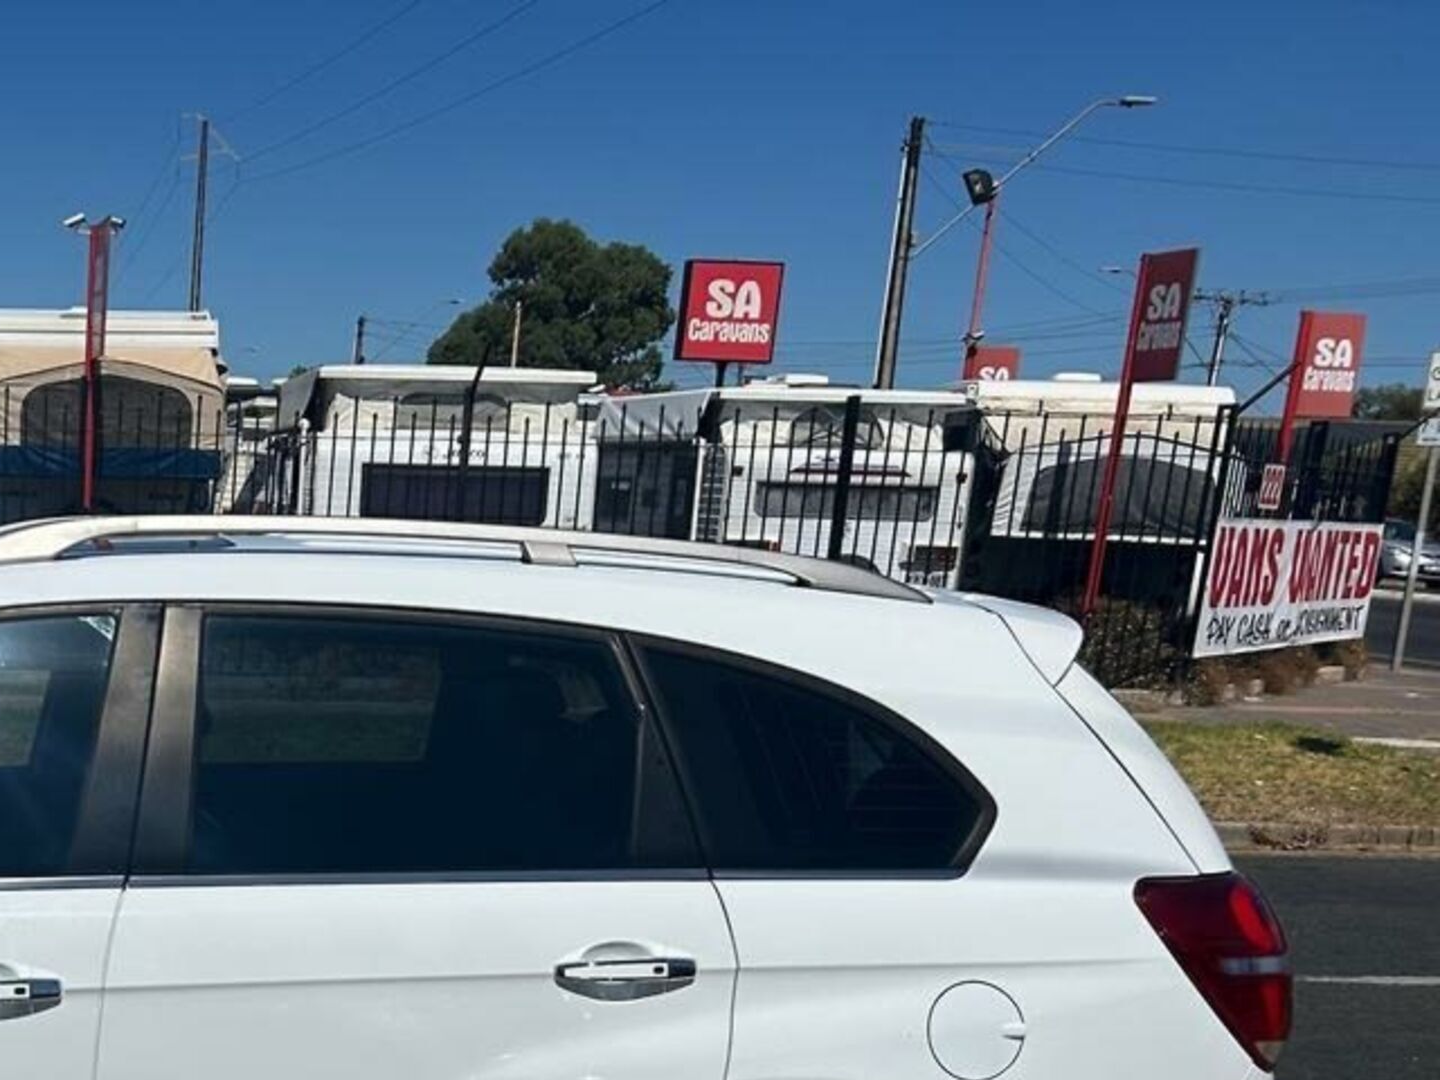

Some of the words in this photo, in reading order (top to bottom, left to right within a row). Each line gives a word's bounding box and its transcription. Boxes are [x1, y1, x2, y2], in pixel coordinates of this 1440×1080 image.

[706, 278, 762, 319] SA
[1148, 282, 1181, 320] SA
[688, 318, 771, 343] Caravans
[1314, 338, 1353, 368] SA
[1208, 525, 1285, 609] VANS
[1289, 529, 1381, 604] WANTED
[1206, 613, 1236, 645] PAY
[1237, 612, 1274, 643] CASH
